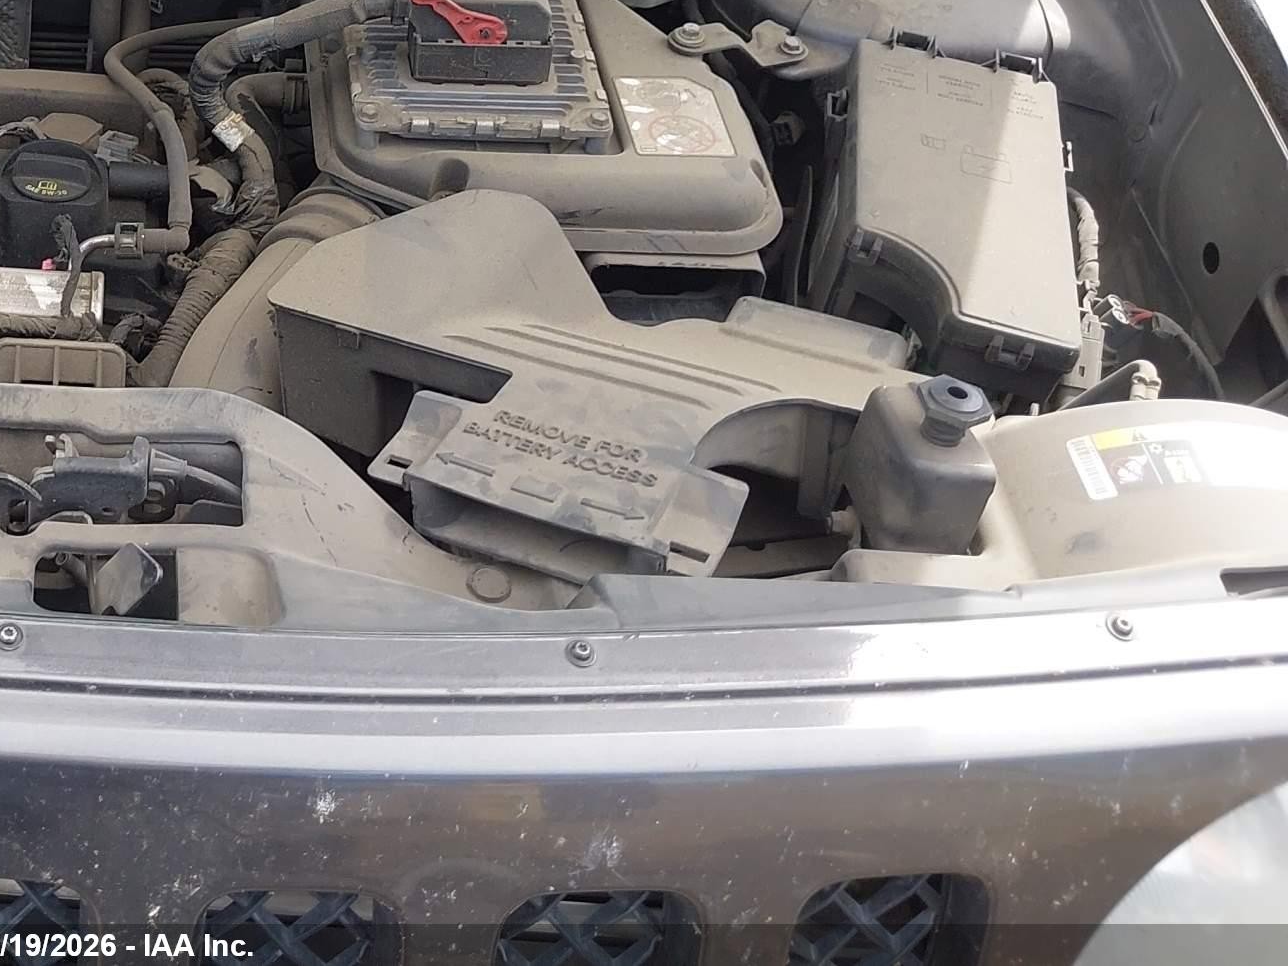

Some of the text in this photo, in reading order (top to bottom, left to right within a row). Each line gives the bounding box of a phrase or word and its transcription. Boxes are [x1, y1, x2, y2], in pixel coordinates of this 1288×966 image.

[24, 184, 40, 194] SAE
[463, 421, 659, 488] BATTERY ACCESS
[493, 409, 643, 464] REMOVE FOR
